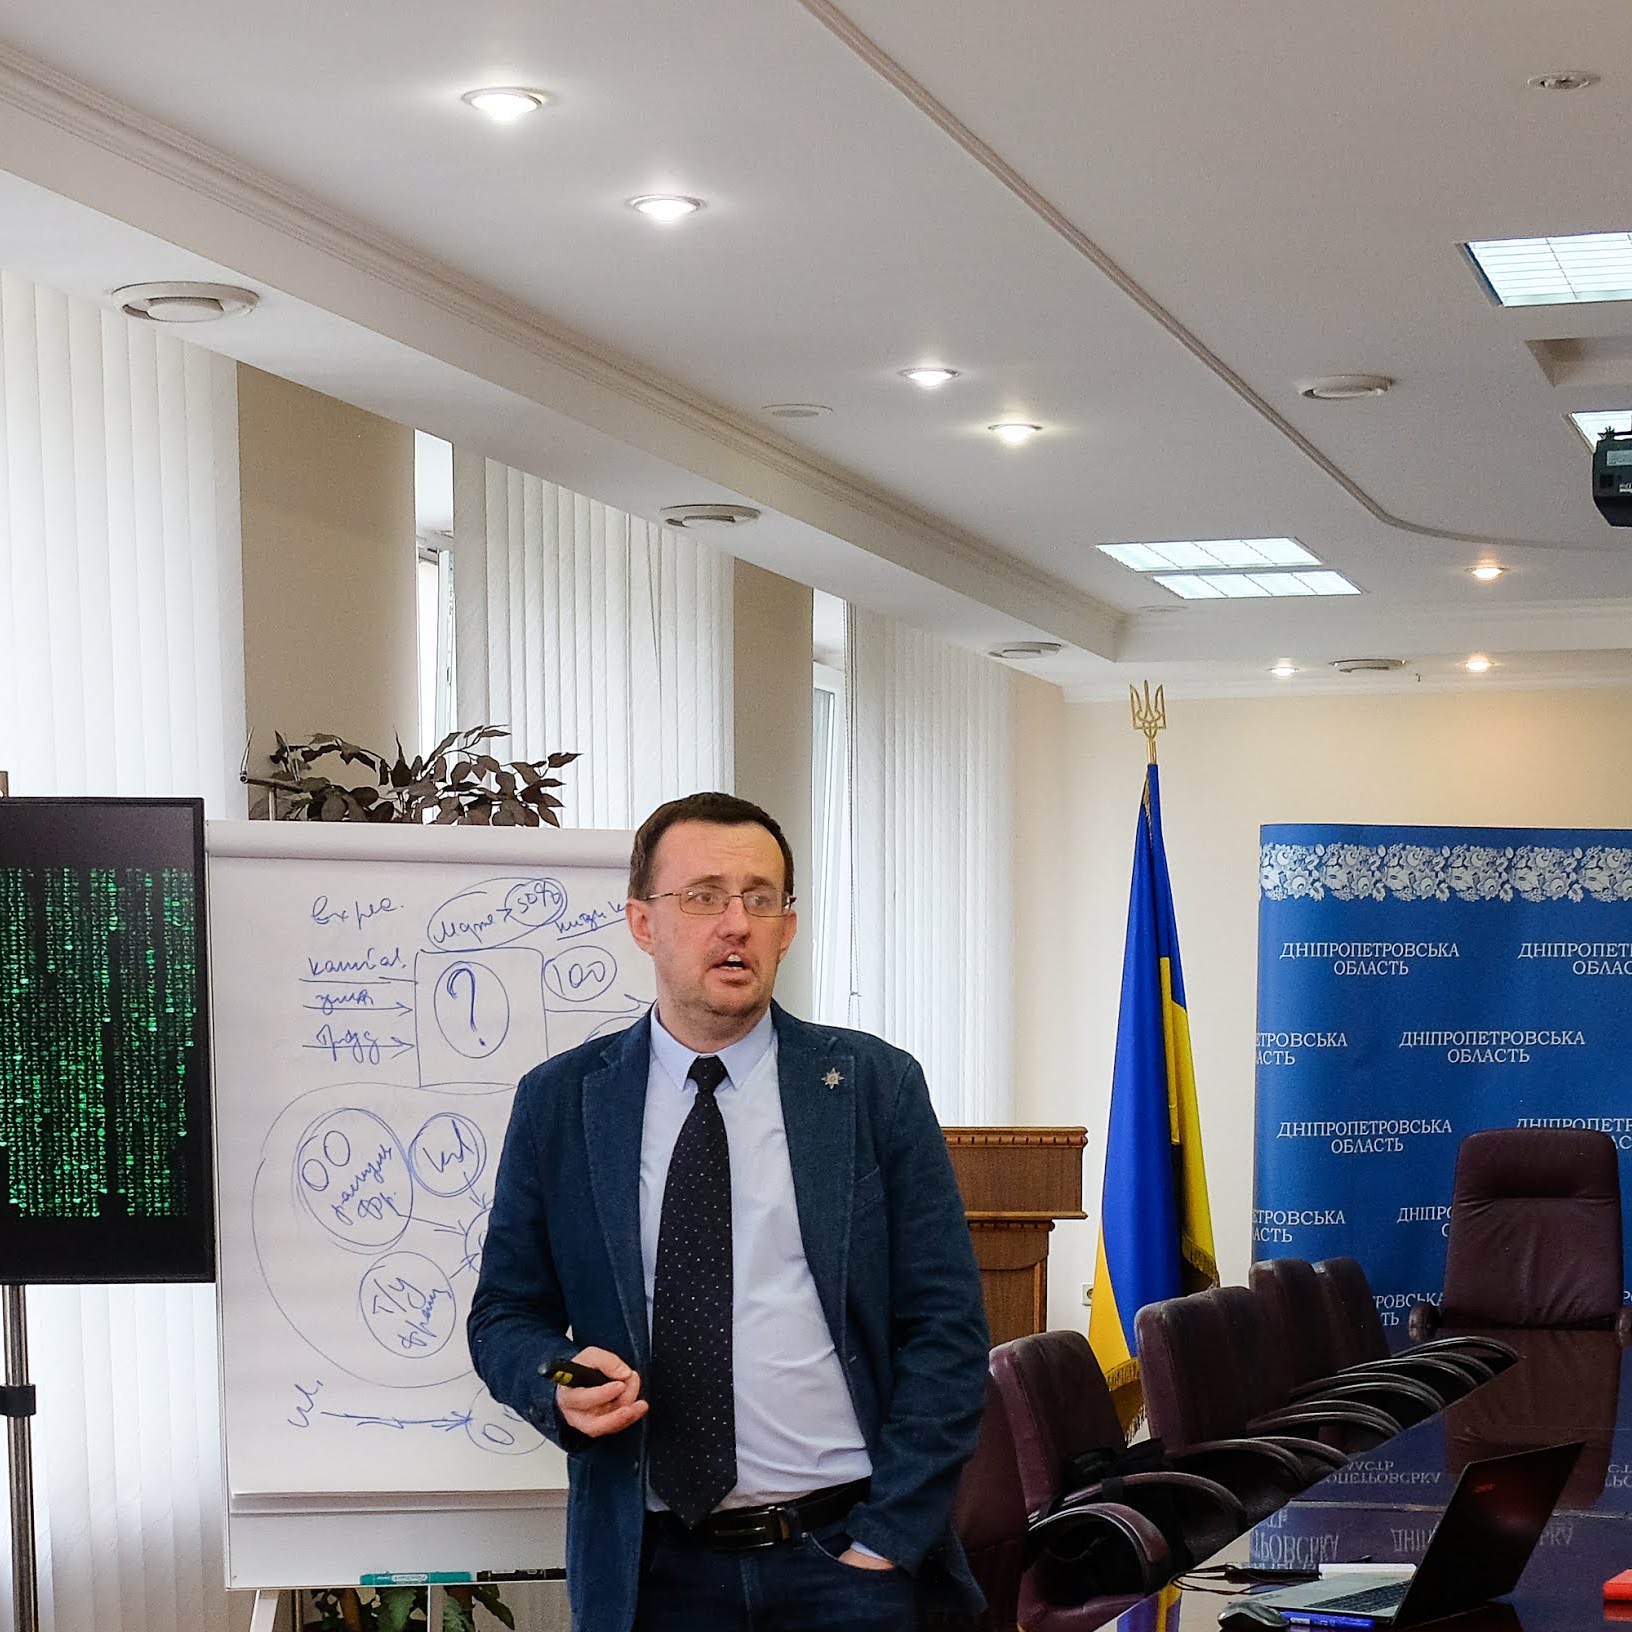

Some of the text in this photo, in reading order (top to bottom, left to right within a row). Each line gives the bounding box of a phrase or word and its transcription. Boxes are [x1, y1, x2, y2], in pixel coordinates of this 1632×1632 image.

[1279, 942, 1460, 959] ДНІПРОПЕТРОВСЬКА
[1334, 960, 1409, 975] ОБЛАСТЬ
[1399, 1031, 1585, 1047] ДНІПРОПЕТРОВСЬКА
[1447, 1048, 1530, 1063] ОБЛАСТЬ
[1277, 1119, 1452, 1138] ДНІПРОПЕТРОВСЬКА
[1331, 1137, 1404, 1154] ОБЛАСТЬ
